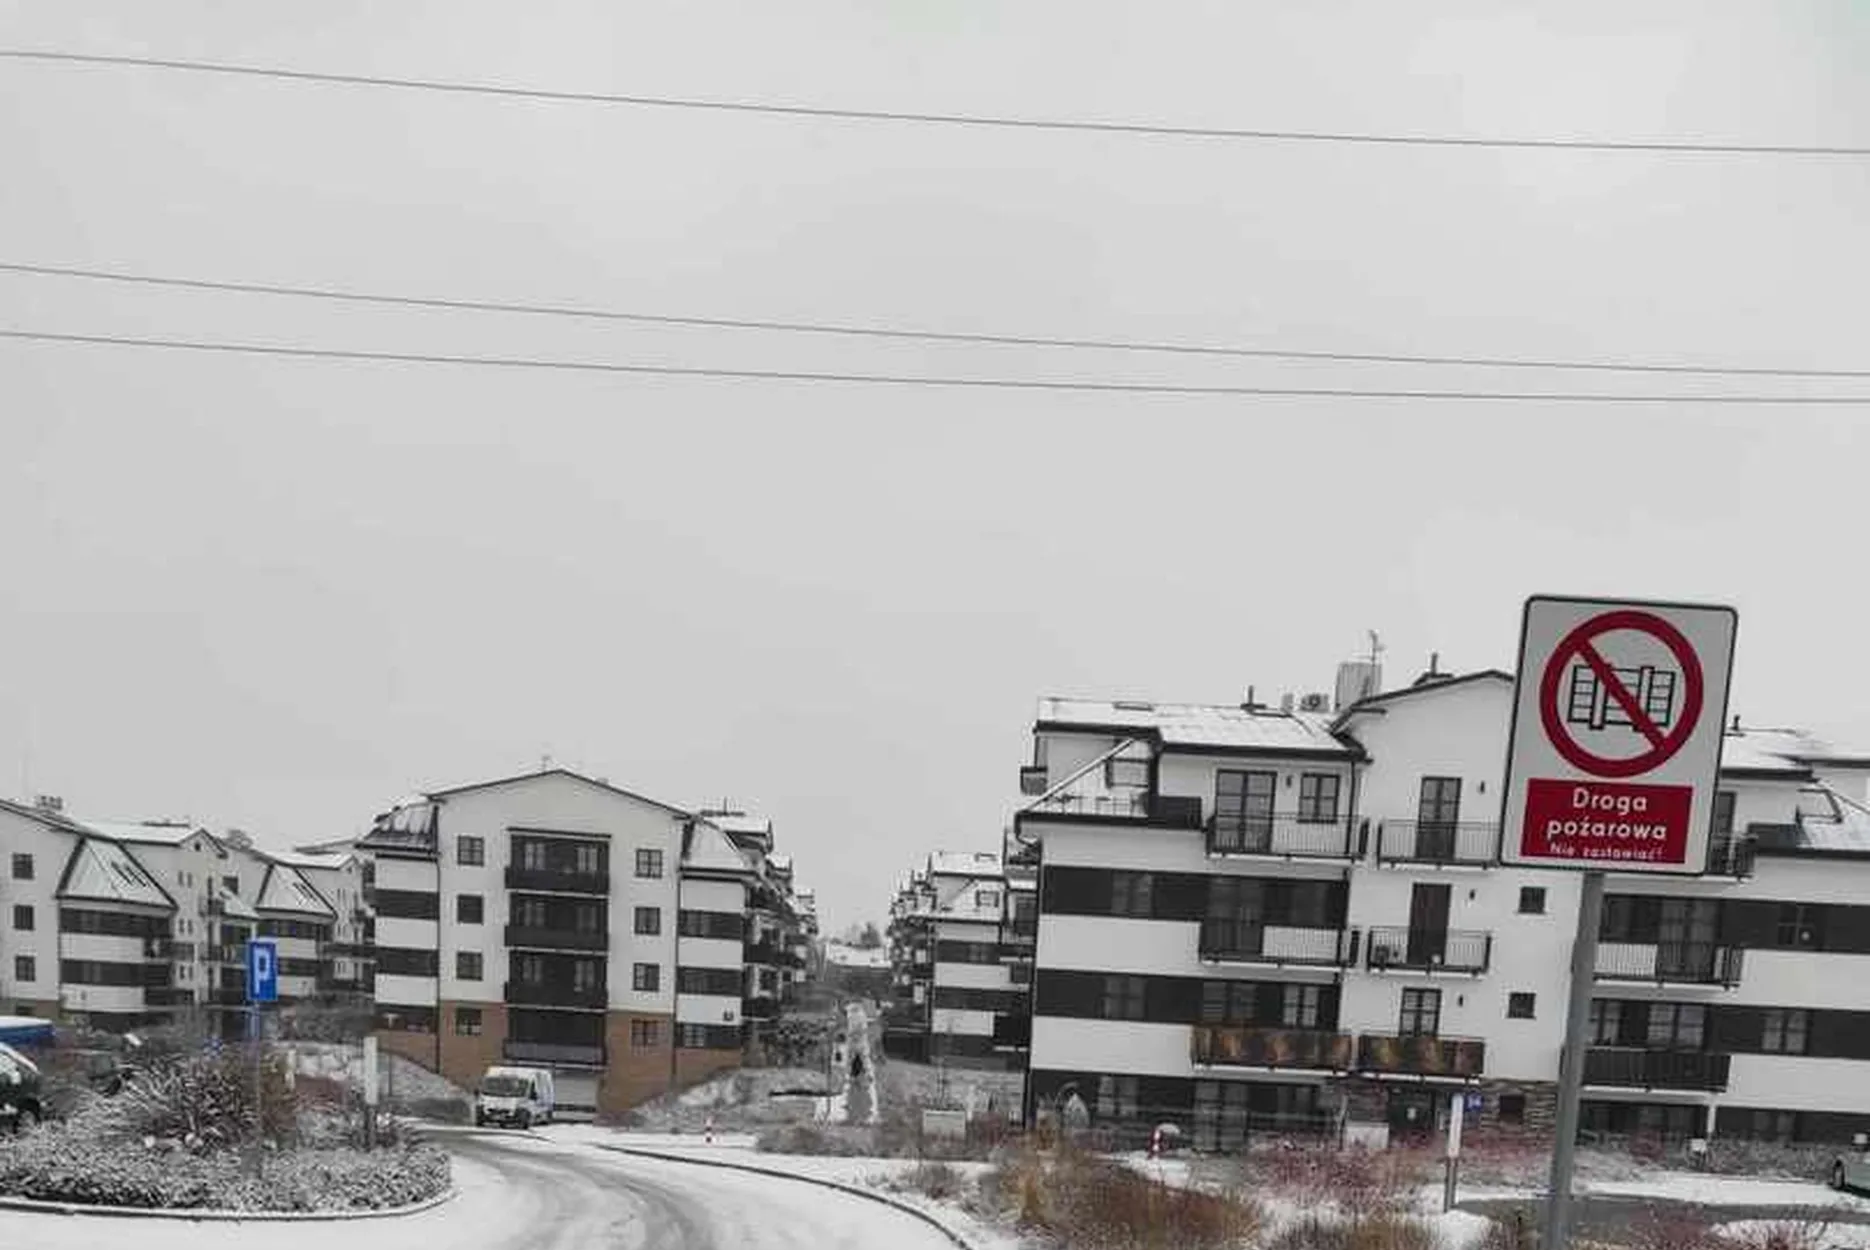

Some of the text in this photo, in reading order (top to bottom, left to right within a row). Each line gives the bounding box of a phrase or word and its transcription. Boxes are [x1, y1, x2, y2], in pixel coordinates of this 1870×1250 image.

[1573, 787, 1647, 815] Droga
[1550, 842, 1575, 857] Nie
[253, 945, 271, 994] P
